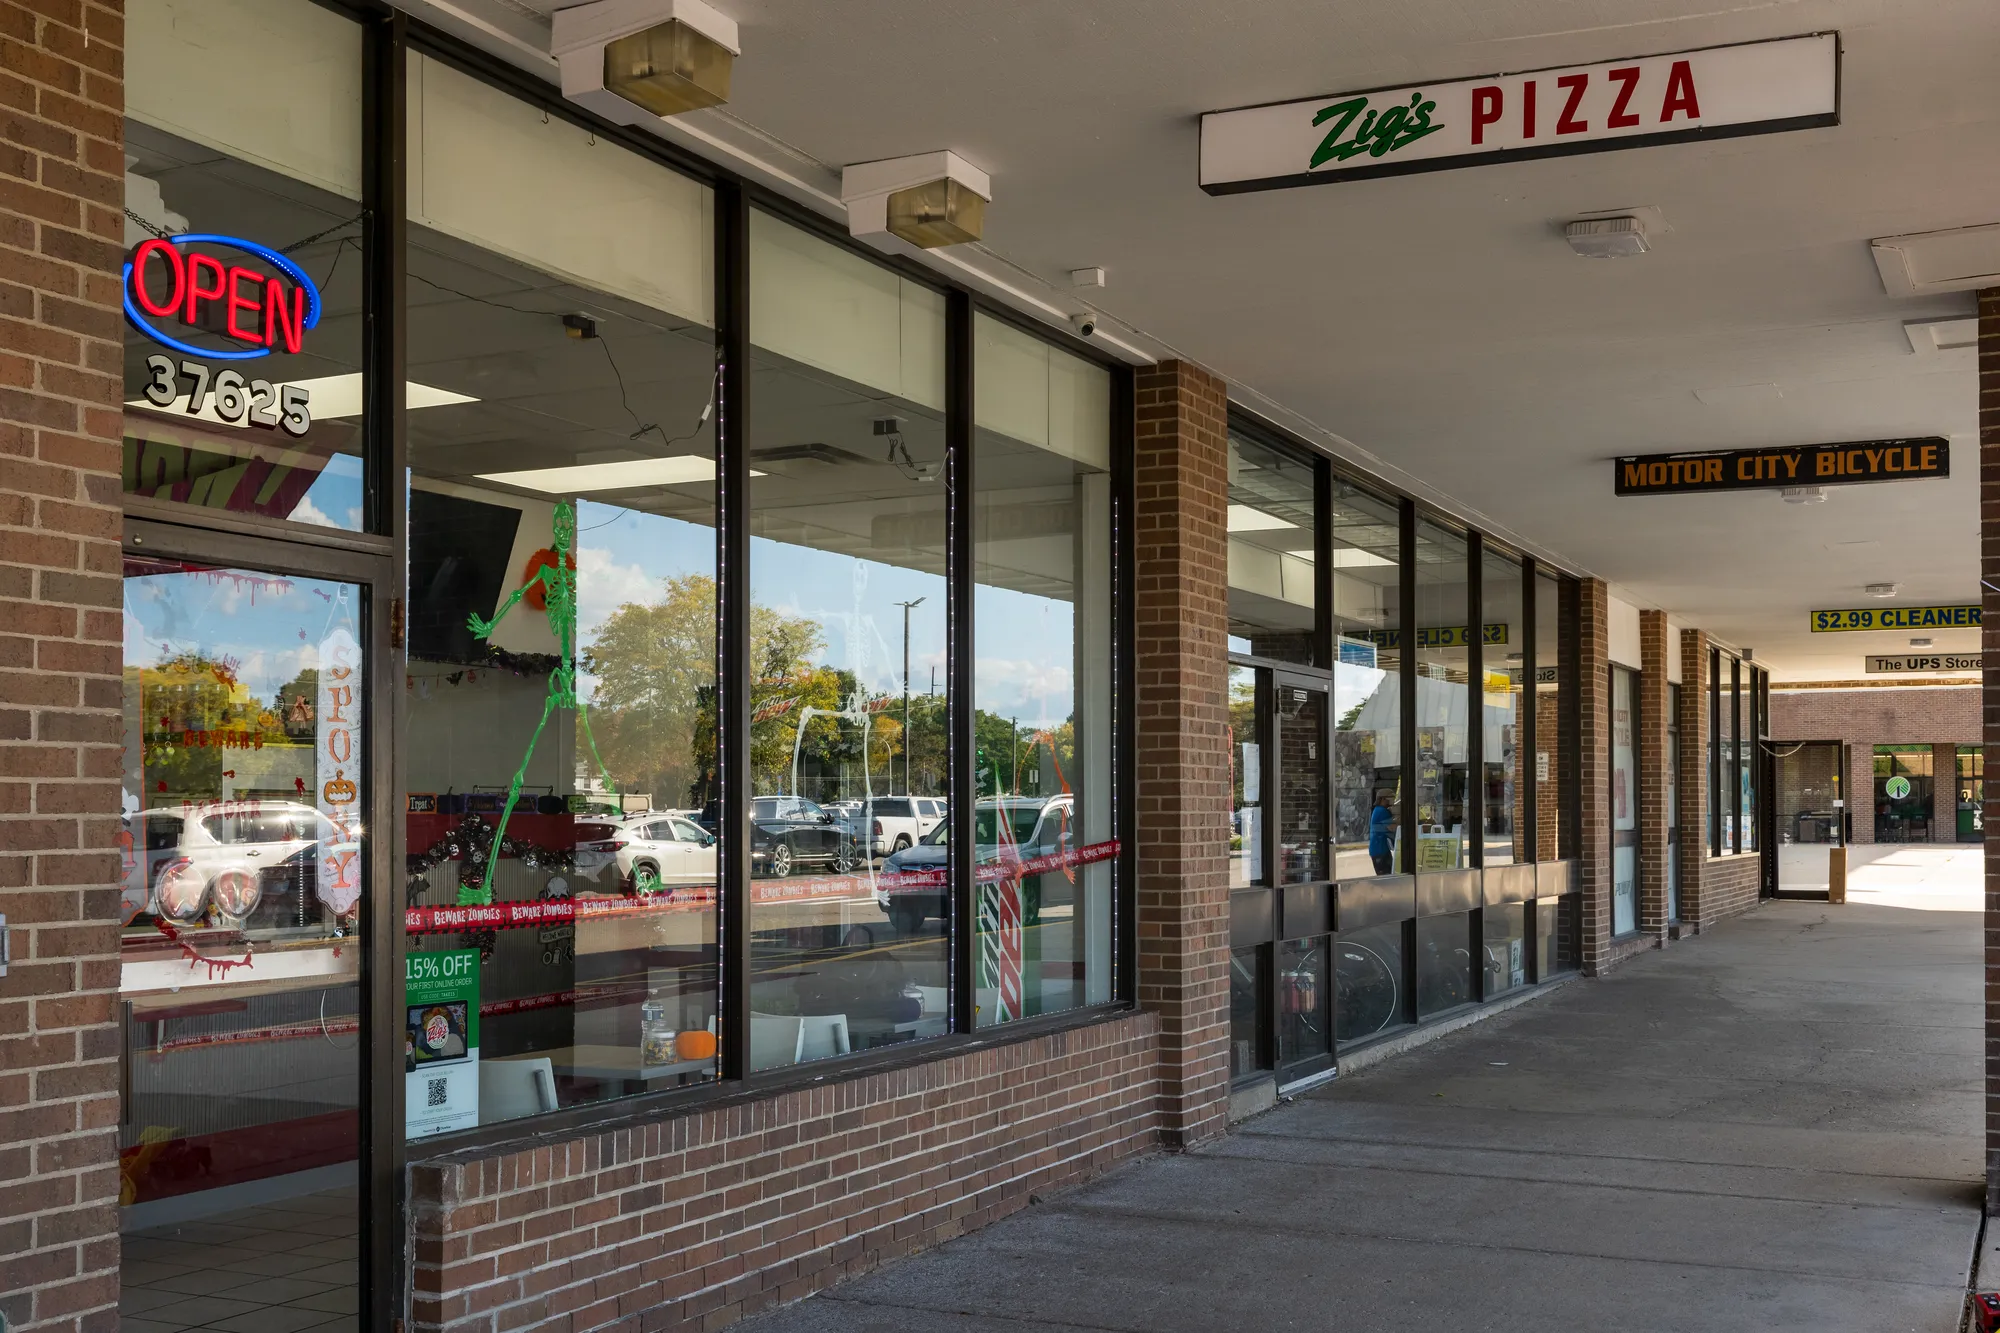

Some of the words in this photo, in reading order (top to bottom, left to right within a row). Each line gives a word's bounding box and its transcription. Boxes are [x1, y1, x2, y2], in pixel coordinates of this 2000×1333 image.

[1309, 92, 1445, 169] Zig's
[1471, 60, 1701, 145] PIZZA
[134, 238, 304, 354] OPEN
[141, 354, 312, 438] 37625
[1624, 458, 1723, 487] MOTOR
[1737, 454, 1801, 480] CITY
[1816, 445, 1938, 476] BICYCLE
[1817, 610, 1873, 630] $2.99
[1876, 659, 1902, 671] The
[1907, 658, 1940, 669] UPS
[1945, 656, 1982, 669] Store
[183, 729, 263, 751] BEWARE
[409, 797, 428, 811] Treat
[434, 910, 466, 925] BEWARE
[468, 907, 501, 921] ZOMBIES
[512, 905, 540, 920] BEWARE
[542, 903, 573, 916] ZOMBIES
[582, 900, 610, 914] BEWARE
[612, 898, 638, 911] ZOMBIES
[648, 894, 672, 908] BEWARE
[673, 893, 698, 905] ZOMBIES
[405, 957, 439, 979] 15%
[442, 954, 473, 976] OFF
[418, 980, 434, 989] FIRST
[434, 980, 454, 988] ONLINE
[454, 977, 473, 986] ORDER
